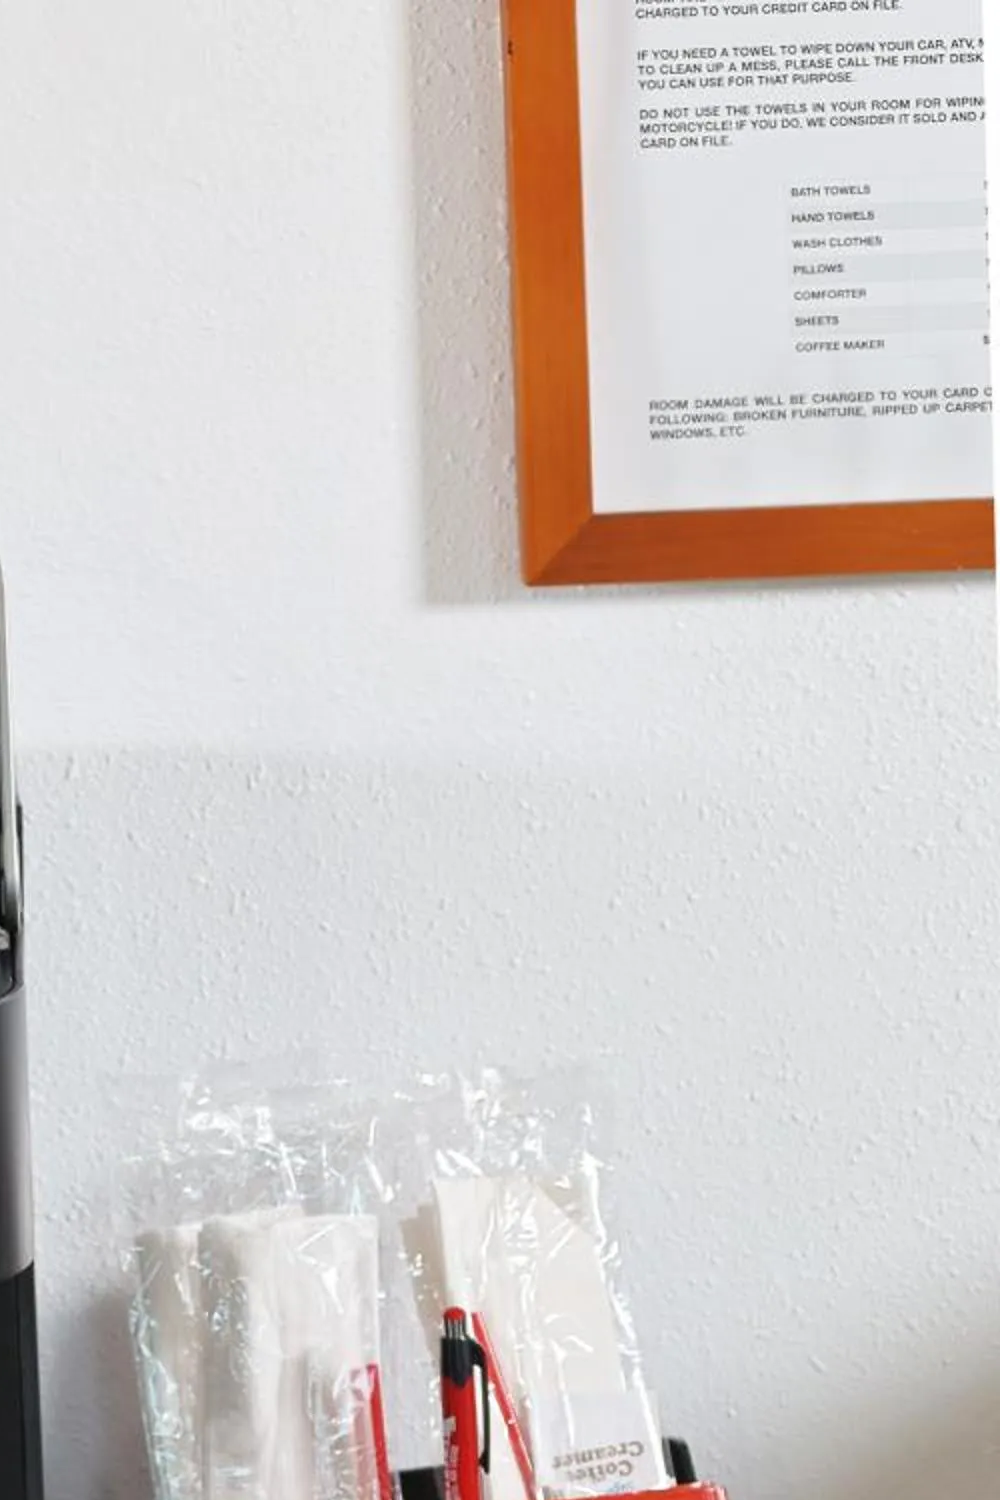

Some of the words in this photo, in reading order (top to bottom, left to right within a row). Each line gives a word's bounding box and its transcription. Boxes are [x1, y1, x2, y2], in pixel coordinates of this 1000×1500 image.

[635, 6, 698, 20] CHARGED
[702, 5, 719, 17] TO
[723, 4, 758, 16] YOUR
[761, 2, 807, 15] CREDIT
[811, 1, 847, 13] CARD
[850, 0, 869, 12] ON
[637, 50, 648, 61] IF
[652, 49, 678, 60] YOU
[683, 47, 716, 59] NEED
[720, 47, 729, 58] A
[733, 45, 776, 57] TOWEL
[780, 44, 797, 56] TO
[800, 43, 832, 55] WIPE
[835, 42, 874, 54] DOWN
[879, 40, 914, 52] YOUR
[637, 64, 655, 76] TO
[660, 63, 702, 75] CLEAN
[706, 62, 724, 73] UP
[728, 61, 737, 73] A
[741, 60, 780, 72] MESS,
[785, 58, 833, 70] PLEASE
[837, 57, 869, 69] CALL
[874, 55, 899, 67] THE
[903, 54, 945, 66] FRONT
[949, 52, 984, 65] DESK
[638, 79, 665, 91] YOU
[669, 78, 696, 90] CAN
[700, 77, 724, 89] USE
[728, 76, 755, 88] FOR
[758, 75, 788, 87] THAT
[639, 108, 659, 120] DO
[663, 107, 689, 119] NOT
[695, 106, 720, 118] USE
[726, 105, 750, 117] THE
[755, 103, 807, 116] TOWELS
[812, 102, 825, 114] IN
[831, 101, 866, 113] YOUR
[871, 99, 911, 112] ROOM
[916, 98, 941, 110] FOR
[639, 120, 733, 134] MOTORCYCLE!
[736, 120, 746, 131] IF
[751, 119, 777, 130] YOU
[806, 117, 826, 128] WE
[829, 114, 895, 127] CONSIDER
[899, 114, 910, 125] IT
[913, 112, 947, 124] SOLD
[950, 111, 977, 123] AND
[640, 137, 676, 149] CARD
[680, 136, 699, 148] ON
[790, 187, 821, 198] BATH
[824, 184, 871, 196] TOWELS
[791, 213, 825, 224] HAND
[827, 210, 875, 222] TOWELS
[792, 238, 826, 250] WASH
[829, 235, 883, 248] CLOTHES
[793, 263, 844, 275] PILLOWS
[793, 288, 867, 301] COMFORTER
[795, 315, 839, 327] SHEETS
[795, 341, 840, 353] COFFEE
[843, 339, 885, 351] MAKER
[649, 399, 688, 411] ROOM
[695, 396, 748, 409] DAMAGE
[754, 395, 783, 407] WILL
[789, 394, 805, 405] BE
[811, 391, 875, 405] CHARGED
[880, 391, 897, 402] TO
[902, 389, 938, 401] YOUR
[943, 387, 979, 399] CARD
[733, 410, 787, 422] BROKEN
[872, 404, 918, 417] RIPPED
[923, 404, 940, 415] UP
